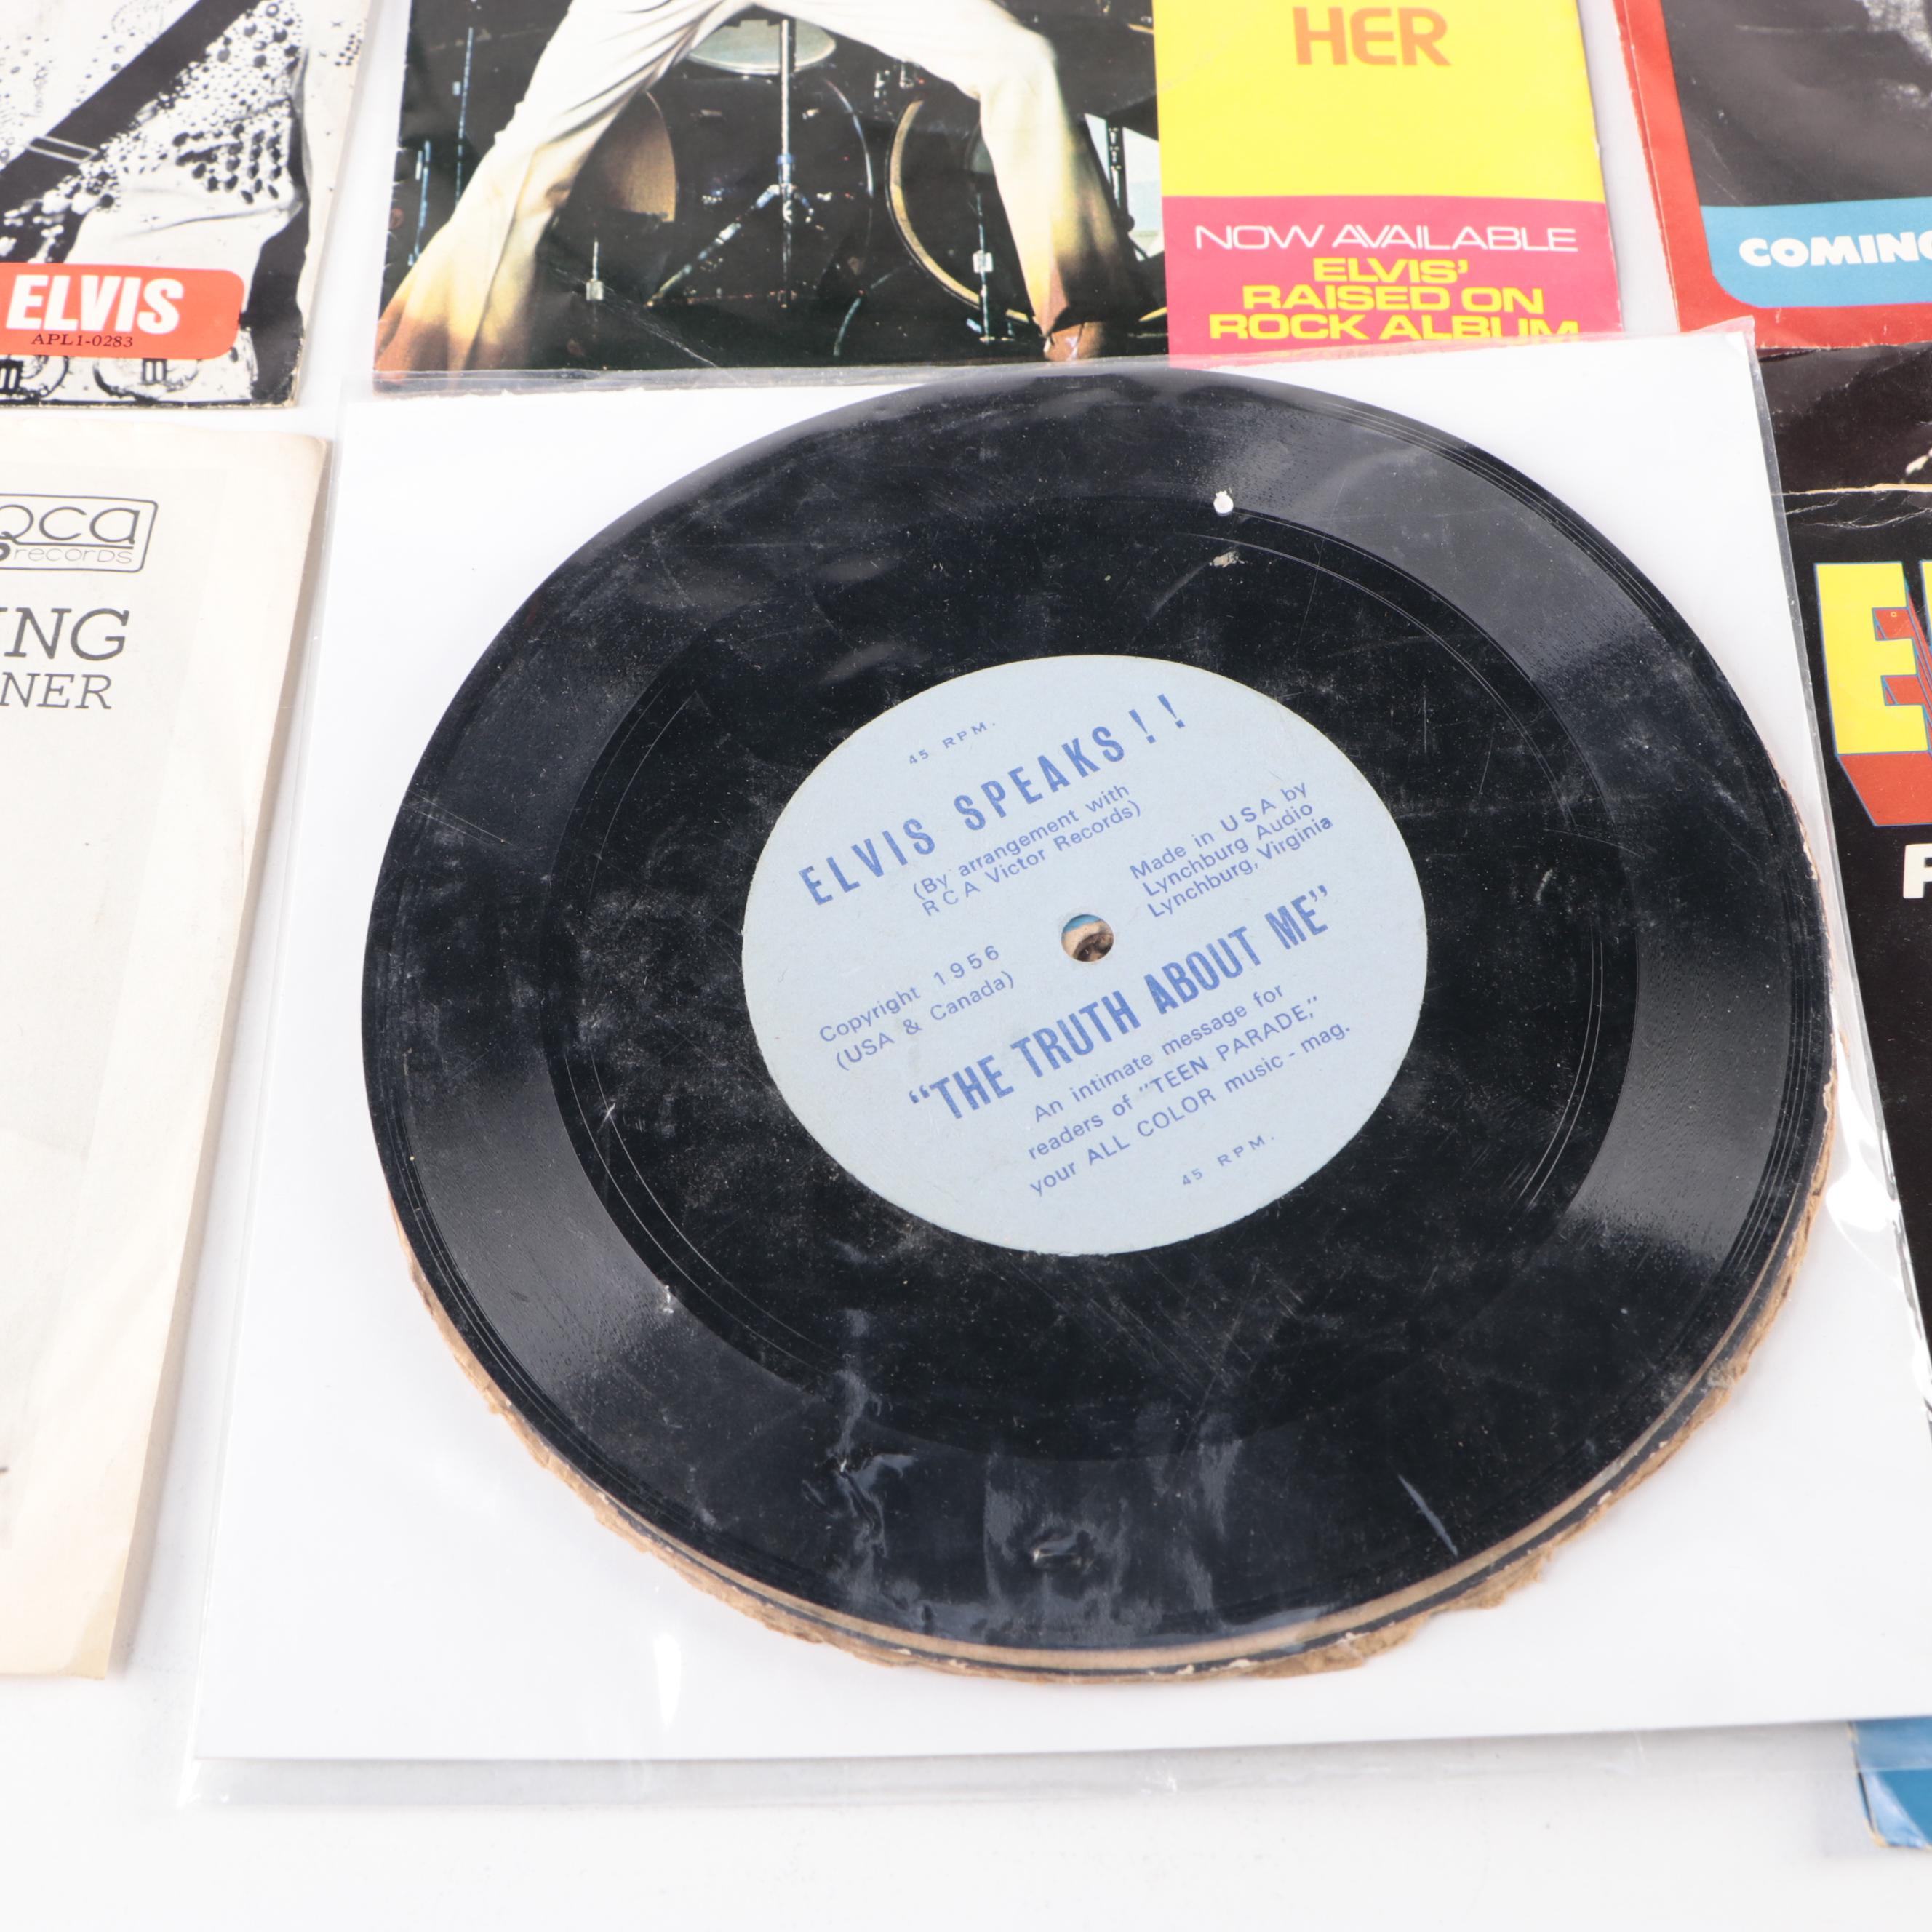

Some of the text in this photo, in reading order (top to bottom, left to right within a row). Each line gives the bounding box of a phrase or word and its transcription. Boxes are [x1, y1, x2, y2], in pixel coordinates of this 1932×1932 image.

[1292, 7, 1452, 66] HER
[1194, 224, 1578, 252] NOW AVAILABLE
[1313, 257, 1469, 284] ELVIS’
[6, 274, 184, 335] ELVIS
[31, 333, 134, 348] APL1-0283
[1208, 314, 1579, 342] ROCK ALBUM
[1242, 285, 1544, 314] RAISED ON
[909, 749, 929, 765] 45
[797, 818, 936, 906] ELVIS
[913, 785, 1130, 902] (By arrangement with
[984, 848, 1045, 884] Victor
[1053, 799, 1141, 852] Records)
[1129, 846, 1187, 879] Made
[1191, 832, 1215, 848] in
[1280, 782, 1306, 810] by
[1141, 804, 1313, 897] Lynchburg Audio
[1146, 817, 1333, 918] Lynchburg, Virginia
[819, 945, 999, 1042] Copyright 1956
[835, 970, 1014, 1071] (USA & Canada)
[908, 1054, 1015, 1119] “THE
[1009, 989, 1141, 1079] TRUTH
[1143, 925, 1261, 1015] ABOUT
[1035, 984, 1283, 1123] An intimate message for
[1028, 1114, 1104, 1160] readers
[1111, 1093, 1133, 1117] of
[1029, 1162, 1077, 1197] your
[1087, 1135, 1131, 1166] ALL
[1136, 1087, 1216, 1137] COLOR
[1224, 1055, 1284, 1093] music
[1300, 1023, 1351, 1053] mag.
[1182, 1167, 1203, 1186] 45
